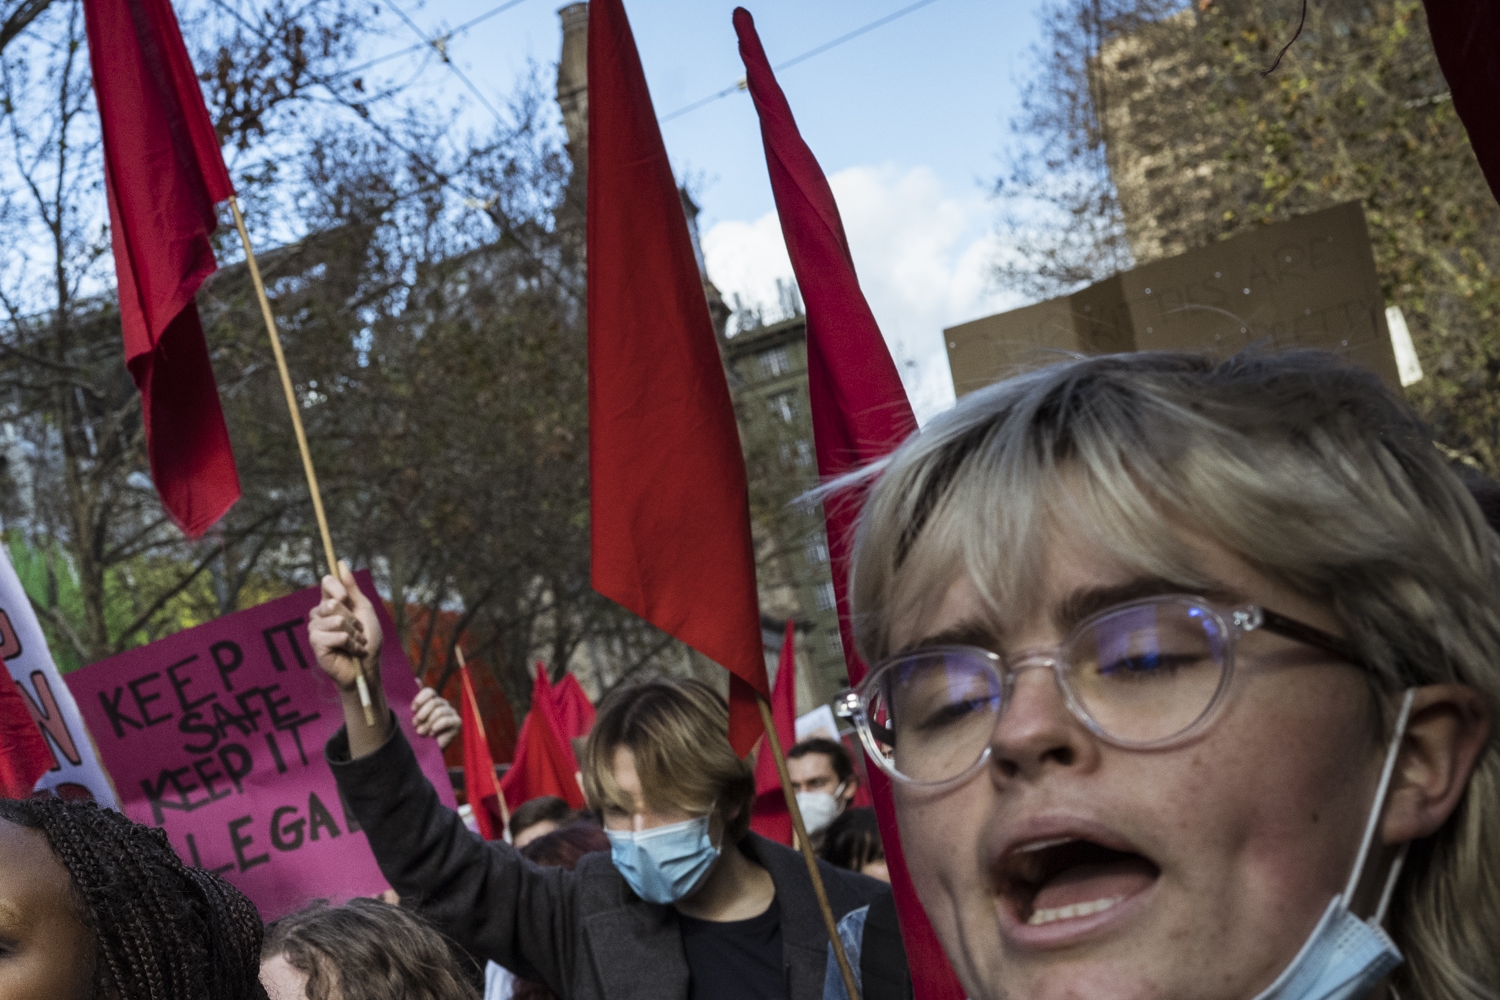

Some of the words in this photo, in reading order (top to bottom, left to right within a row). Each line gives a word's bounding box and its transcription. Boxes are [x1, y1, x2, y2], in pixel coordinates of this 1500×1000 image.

[100, 640, 244, 740] KEEP
[262, 618, 309, 671] IT
[178, 684, 293, 754] SAFE
[140, 743, 253, 825] KEEP
[265, 711, 321, 773] IT
